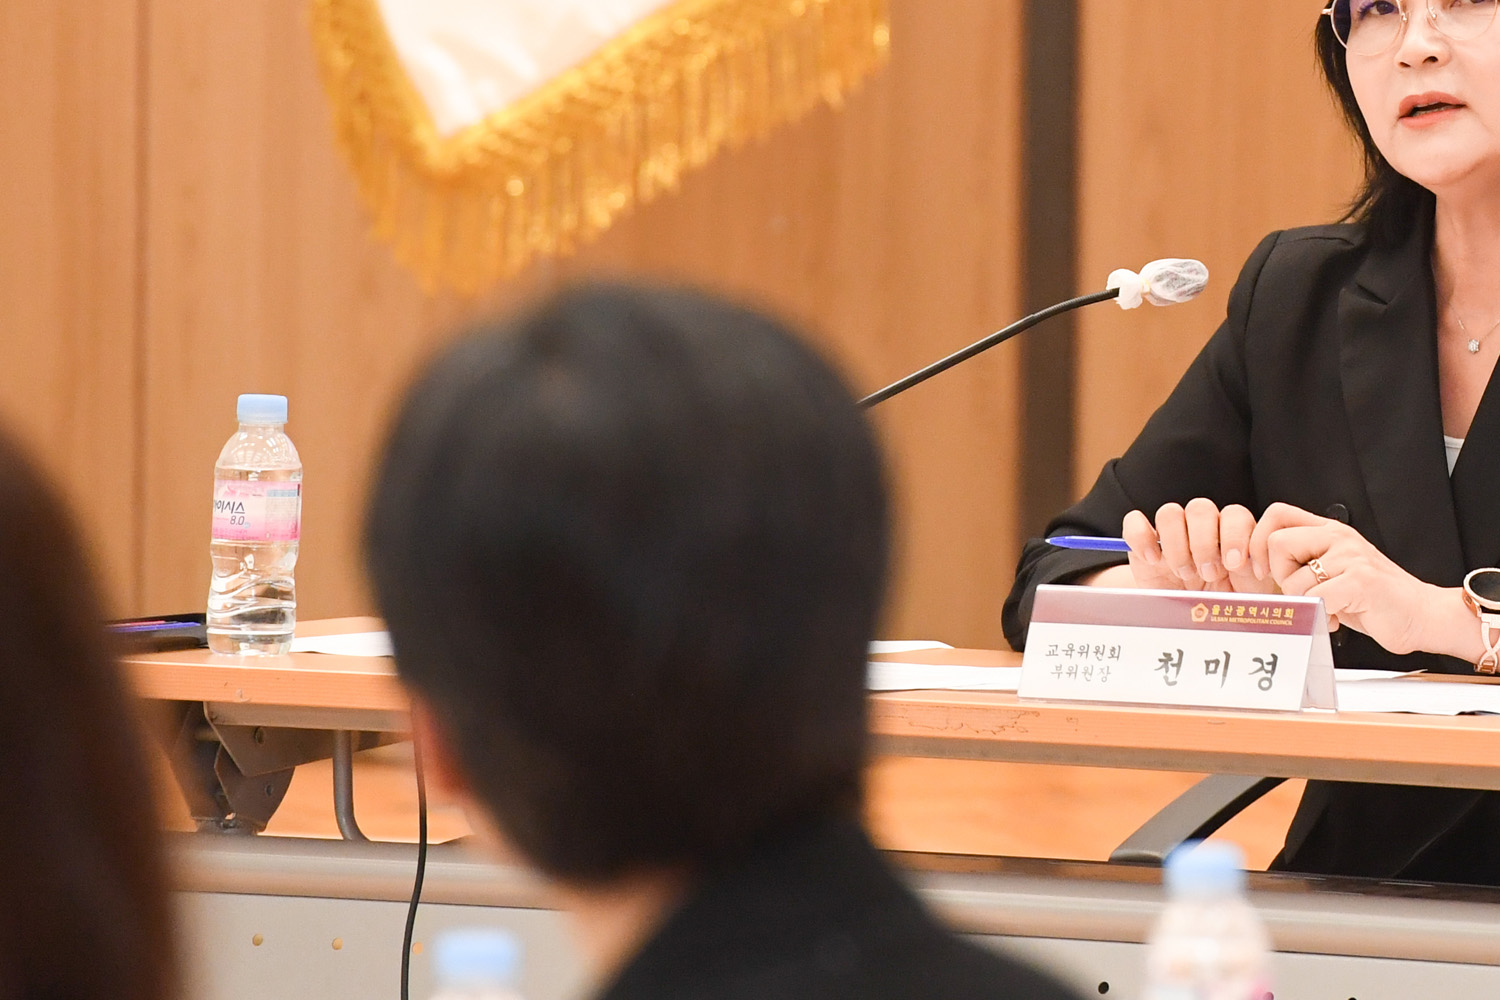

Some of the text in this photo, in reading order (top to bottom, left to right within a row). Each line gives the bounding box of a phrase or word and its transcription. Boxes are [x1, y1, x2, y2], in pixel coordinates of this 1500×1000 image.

[230, 515, 245, 526] 8.0
[1211, 604, 1295, 619] 울산광역시의회
[1045, 642, 1122, 662] 교육위원회
[1050, 664, 1111, 683] 부위원장
